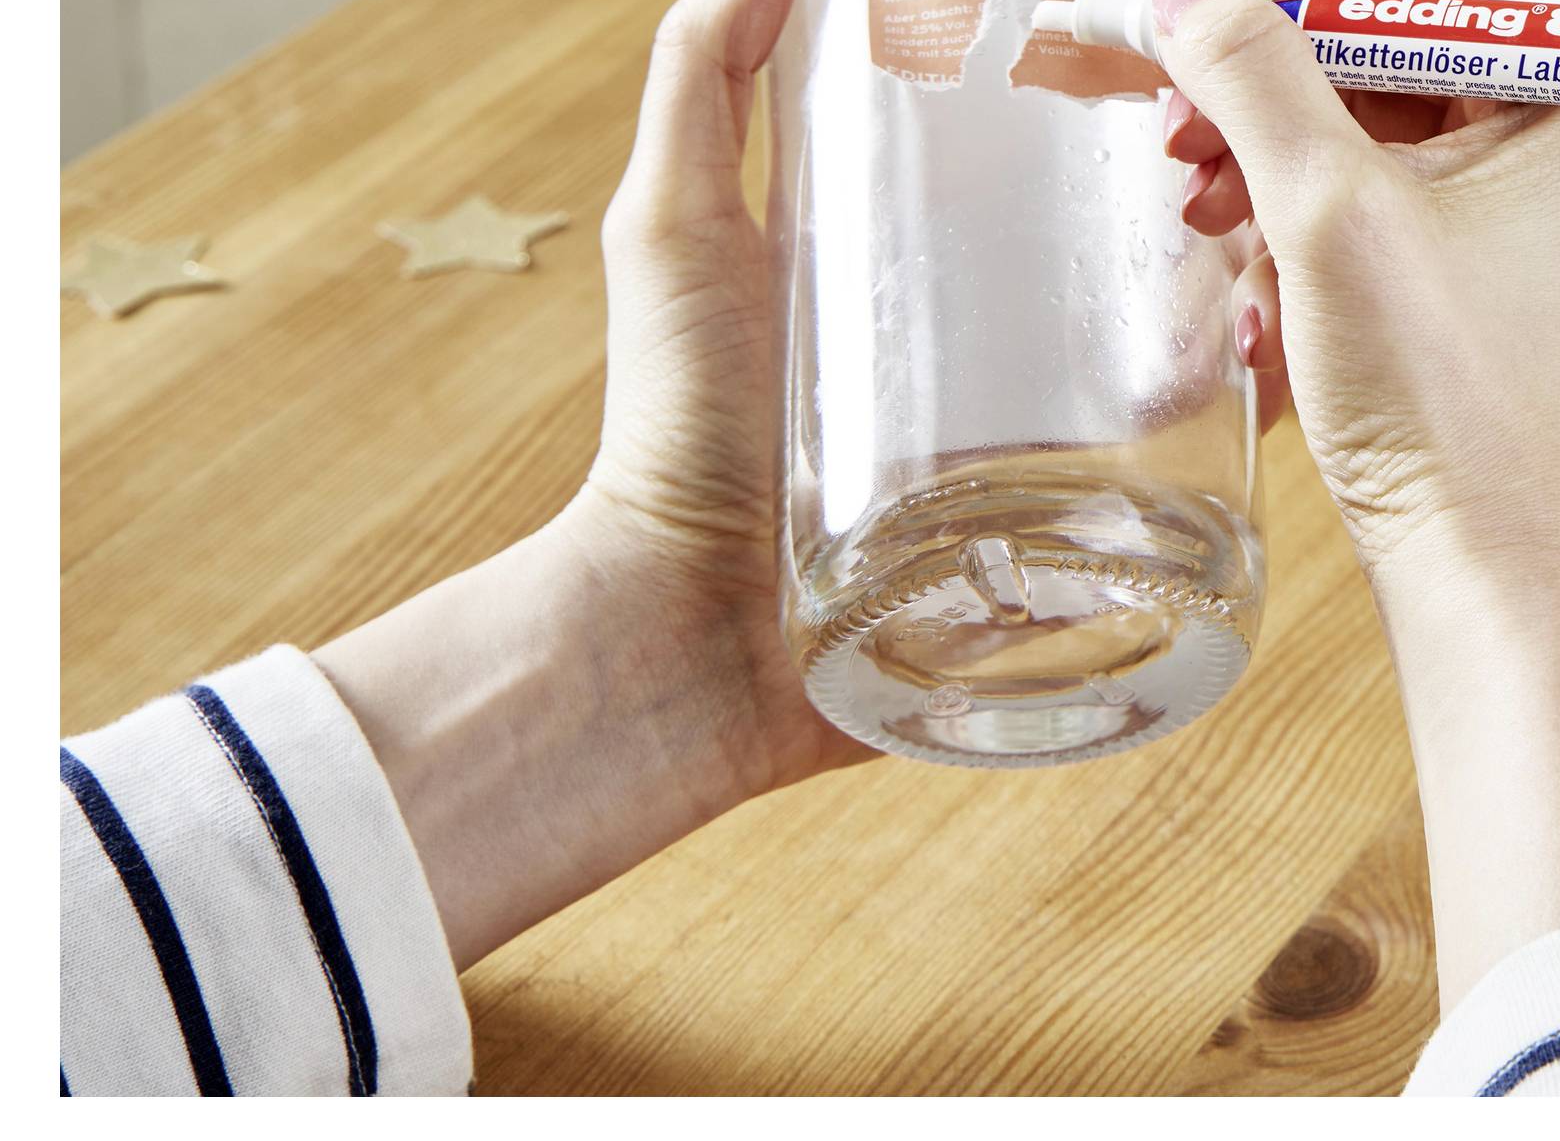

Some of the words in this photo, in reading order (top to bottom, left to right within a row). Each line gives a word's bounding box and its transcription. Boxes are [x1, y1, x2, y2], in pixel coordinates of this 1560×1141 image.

[917, 49, 939, 59] mit
[1310, 37, 1498, 77] tikettenlöser
[886, 65, 964, 86] EDITIO
[1324, 70, 1338, 79] per
[1341, 70, 1366, 81] labels
[1368, 73, 1384, 82] and
[1387, 75, 1423, 85] adhesive
[1425, 78, 1457, 88] residue
[1465, 81, 1497, 91] precise
[1499, 83, 1515, 92] and
[1517, 86, 1538, 95] easy
[1540, 86, 1549, 95] to
[1370, 81, 1387, 89] first
[1394, 83, 1416, 91] leave
[1459, 88, 1493, 97] minutes
[1494, 90, 1504, 98] to
[1506, 91, 1525, 99] take
[1527, 93, 1552, 101] effect
